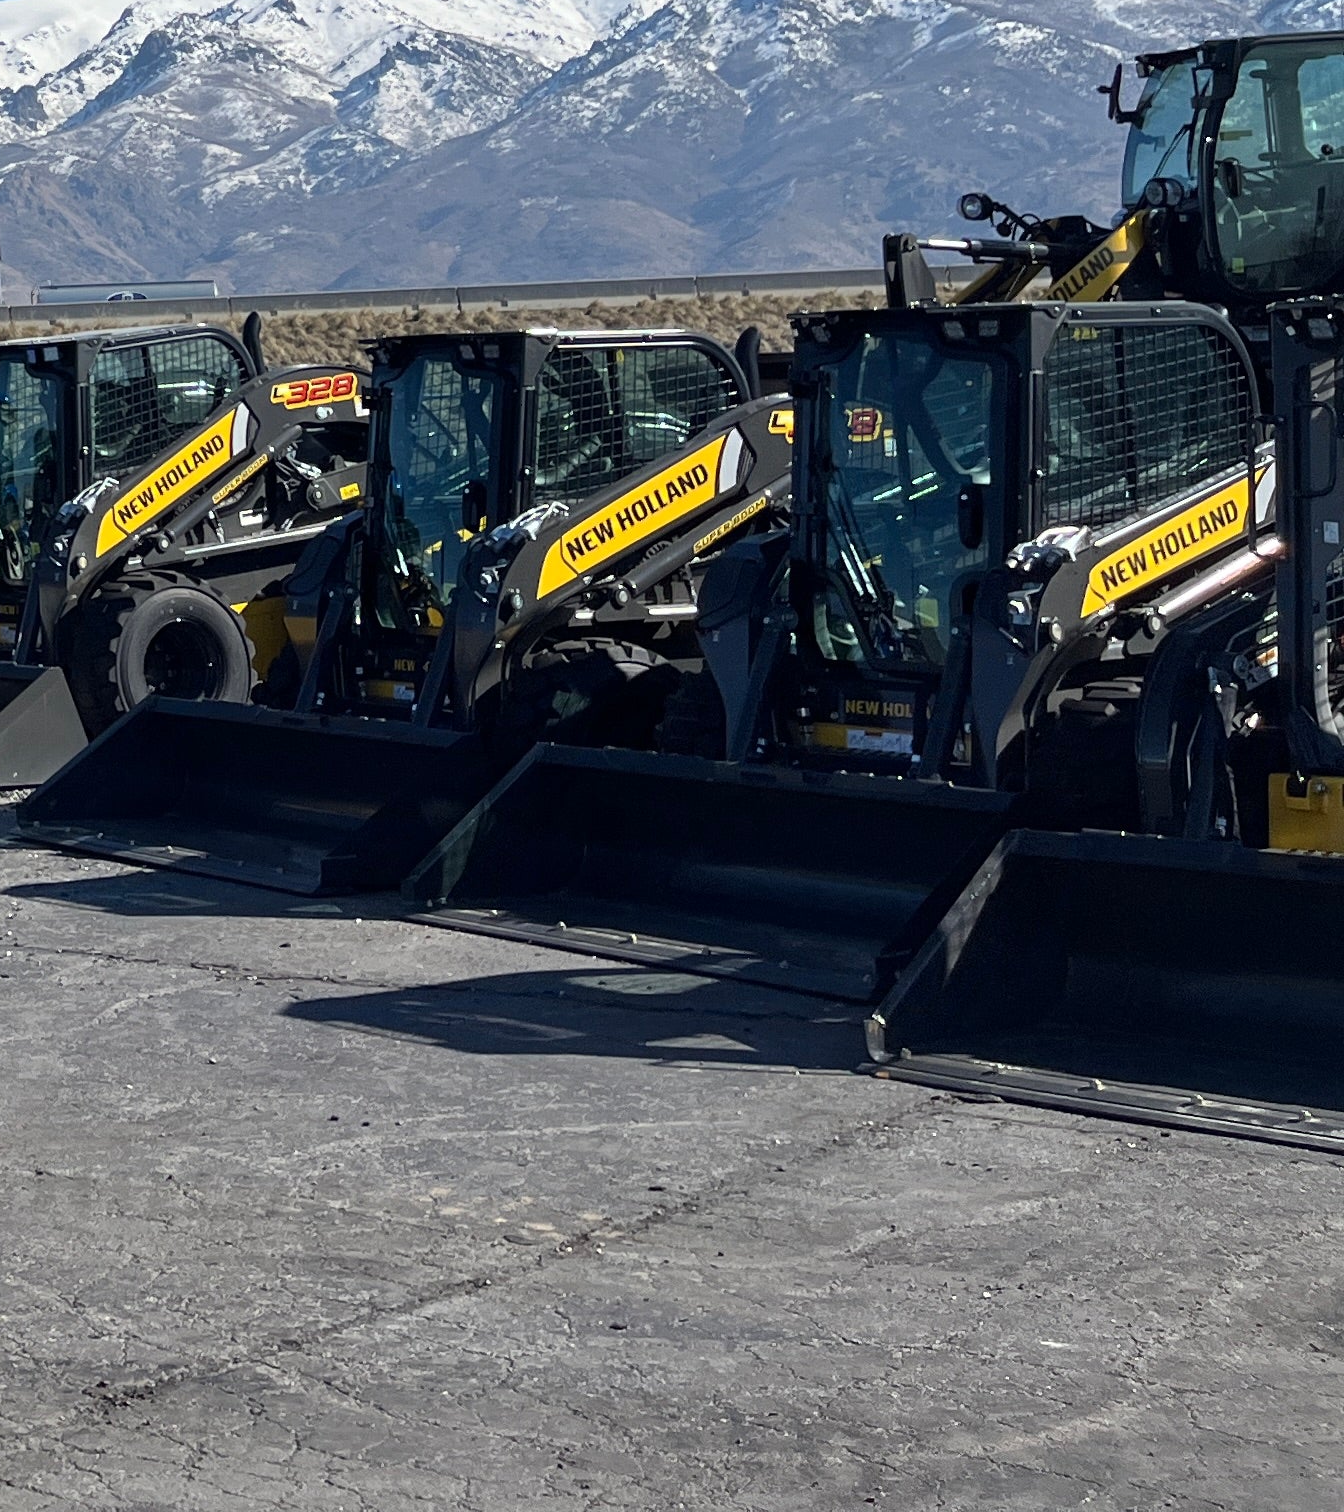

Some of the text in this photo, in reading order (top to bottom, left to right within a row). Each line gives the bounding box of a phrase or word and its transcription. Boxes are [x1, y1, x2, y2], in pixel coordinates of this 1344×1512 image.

[1048, 247, 1114, 302] OLLAND
[273, 375, 355, 405] L328
[117, 435, 224, 524] NEW HOLLAND
[566, 464, 709, 561] NEW HOLLAND
[694, 497, 767, 551] SUPER BOOM
[1100, 500, 1238, 591] NEW HOLLAND
[394, 659, 416, 672] NEW
[845, 699, 880, 716] NEW
